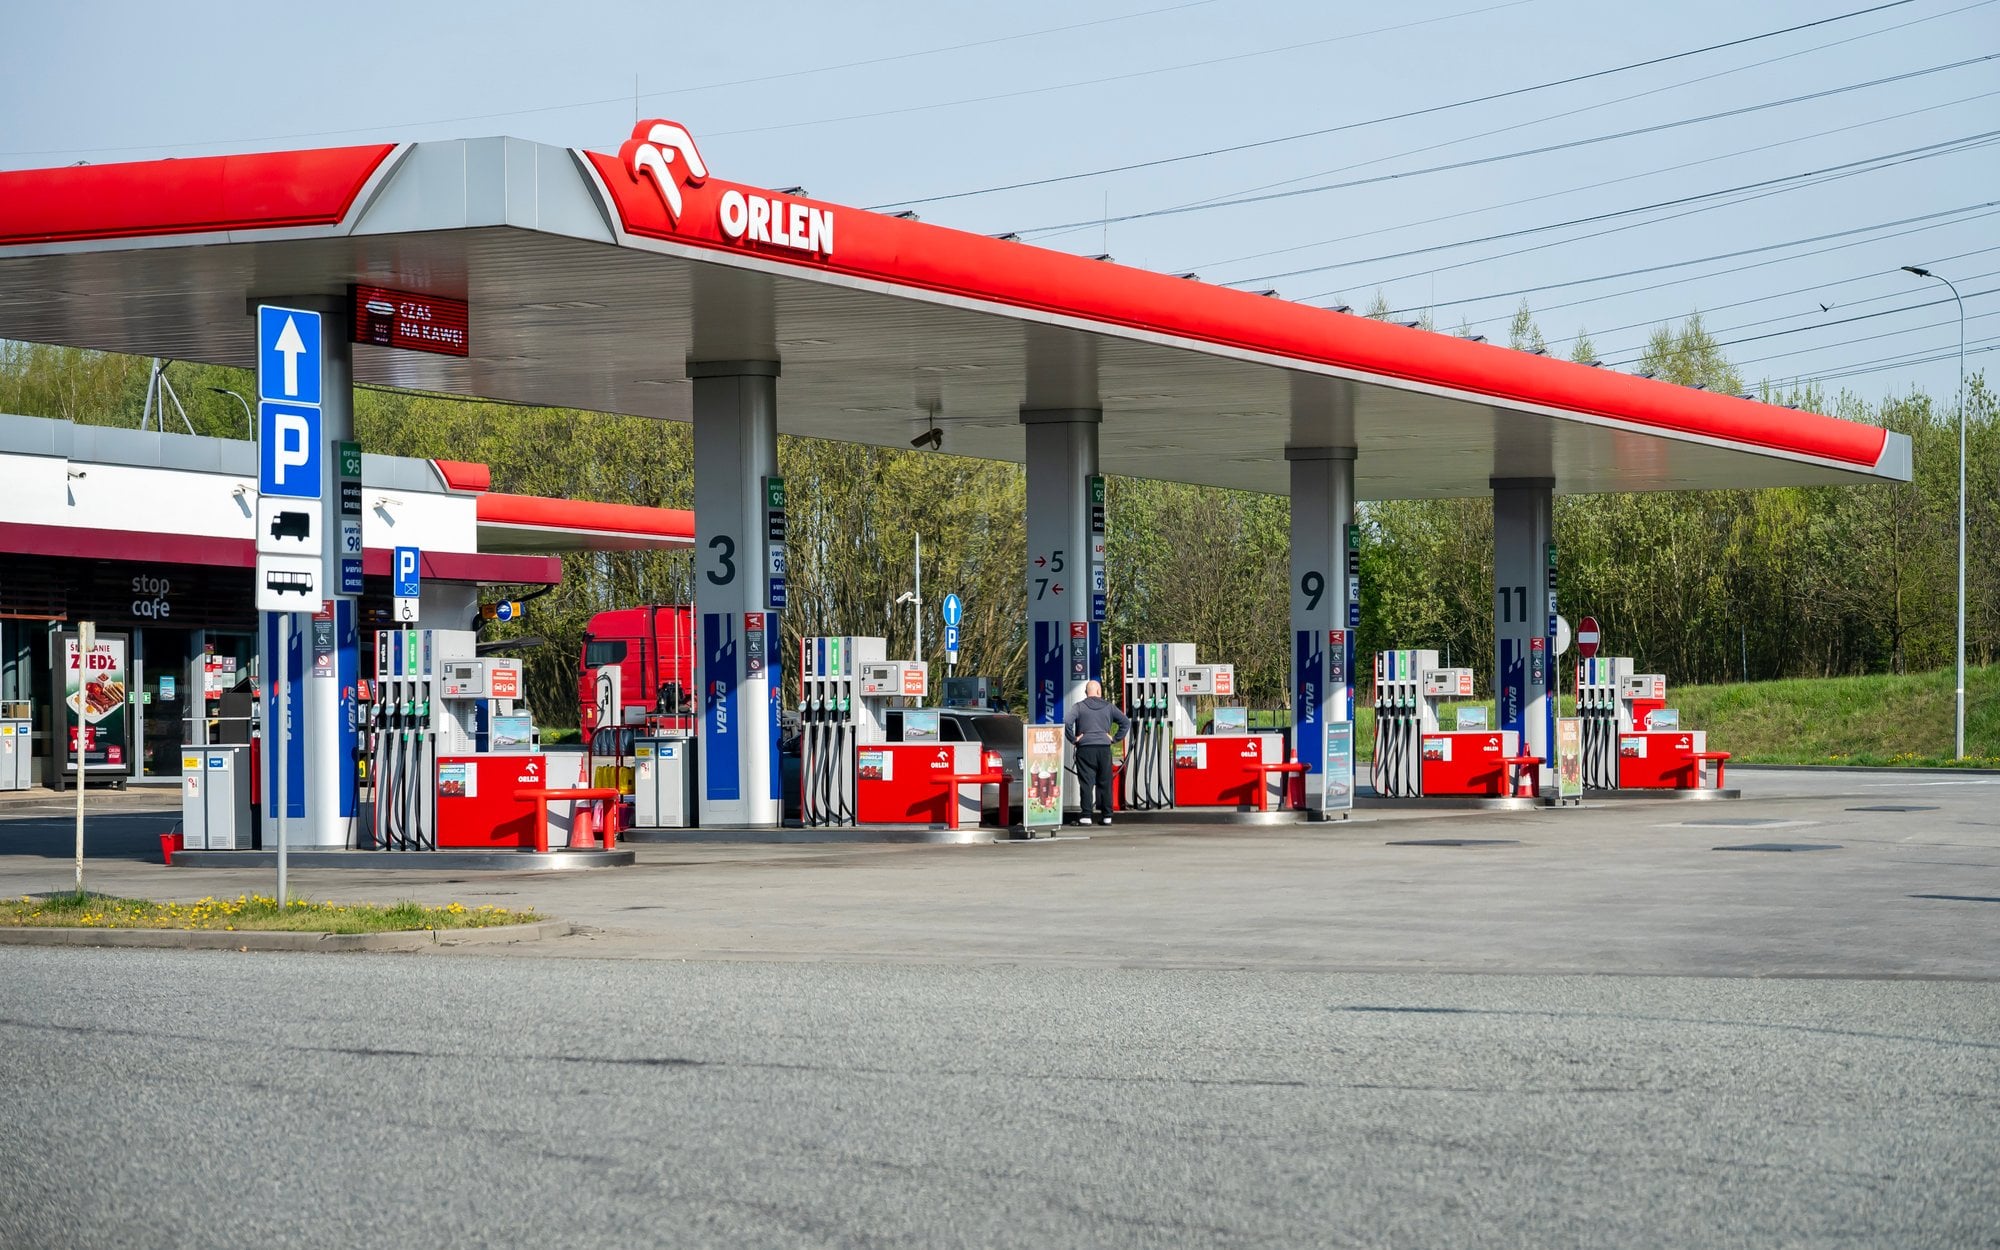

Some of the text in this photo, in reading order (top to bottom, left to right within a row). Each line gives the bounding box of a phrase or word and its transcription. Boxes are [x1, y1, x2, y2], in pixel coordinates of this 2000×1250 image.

[719, 190, 834, 255] ORLEN
[400, 302, 432, 320] CZAS
[400, 323, 420, 337] NA
[275, 414, 309, 485] P
[347, 459, 360, 474] 95
[347, 536, 360, 551] 98
[400, 551, 415, 582] P
[707, 535, 736, 586] 3
[1051, 551, 1064, 572] 5
[132, 574, 170, 599] stop
[1035, 578, 1048, 600] 7
[1301, 571, 1324, 610] 9
[132, 598, 170, 619] cafe
[1498, 587, 1526, 622] 11
[70, 641, 110, 652] ŚNANIE
[948, 630, 956, 648] P
[348, 686, 356, 733] verva
[716, 680, 727, 733] verva
[1045, 679, 1054, 724] verva
[1305, 682, 1314, 724] verva
[1509, 686, 1517, 723] verva
